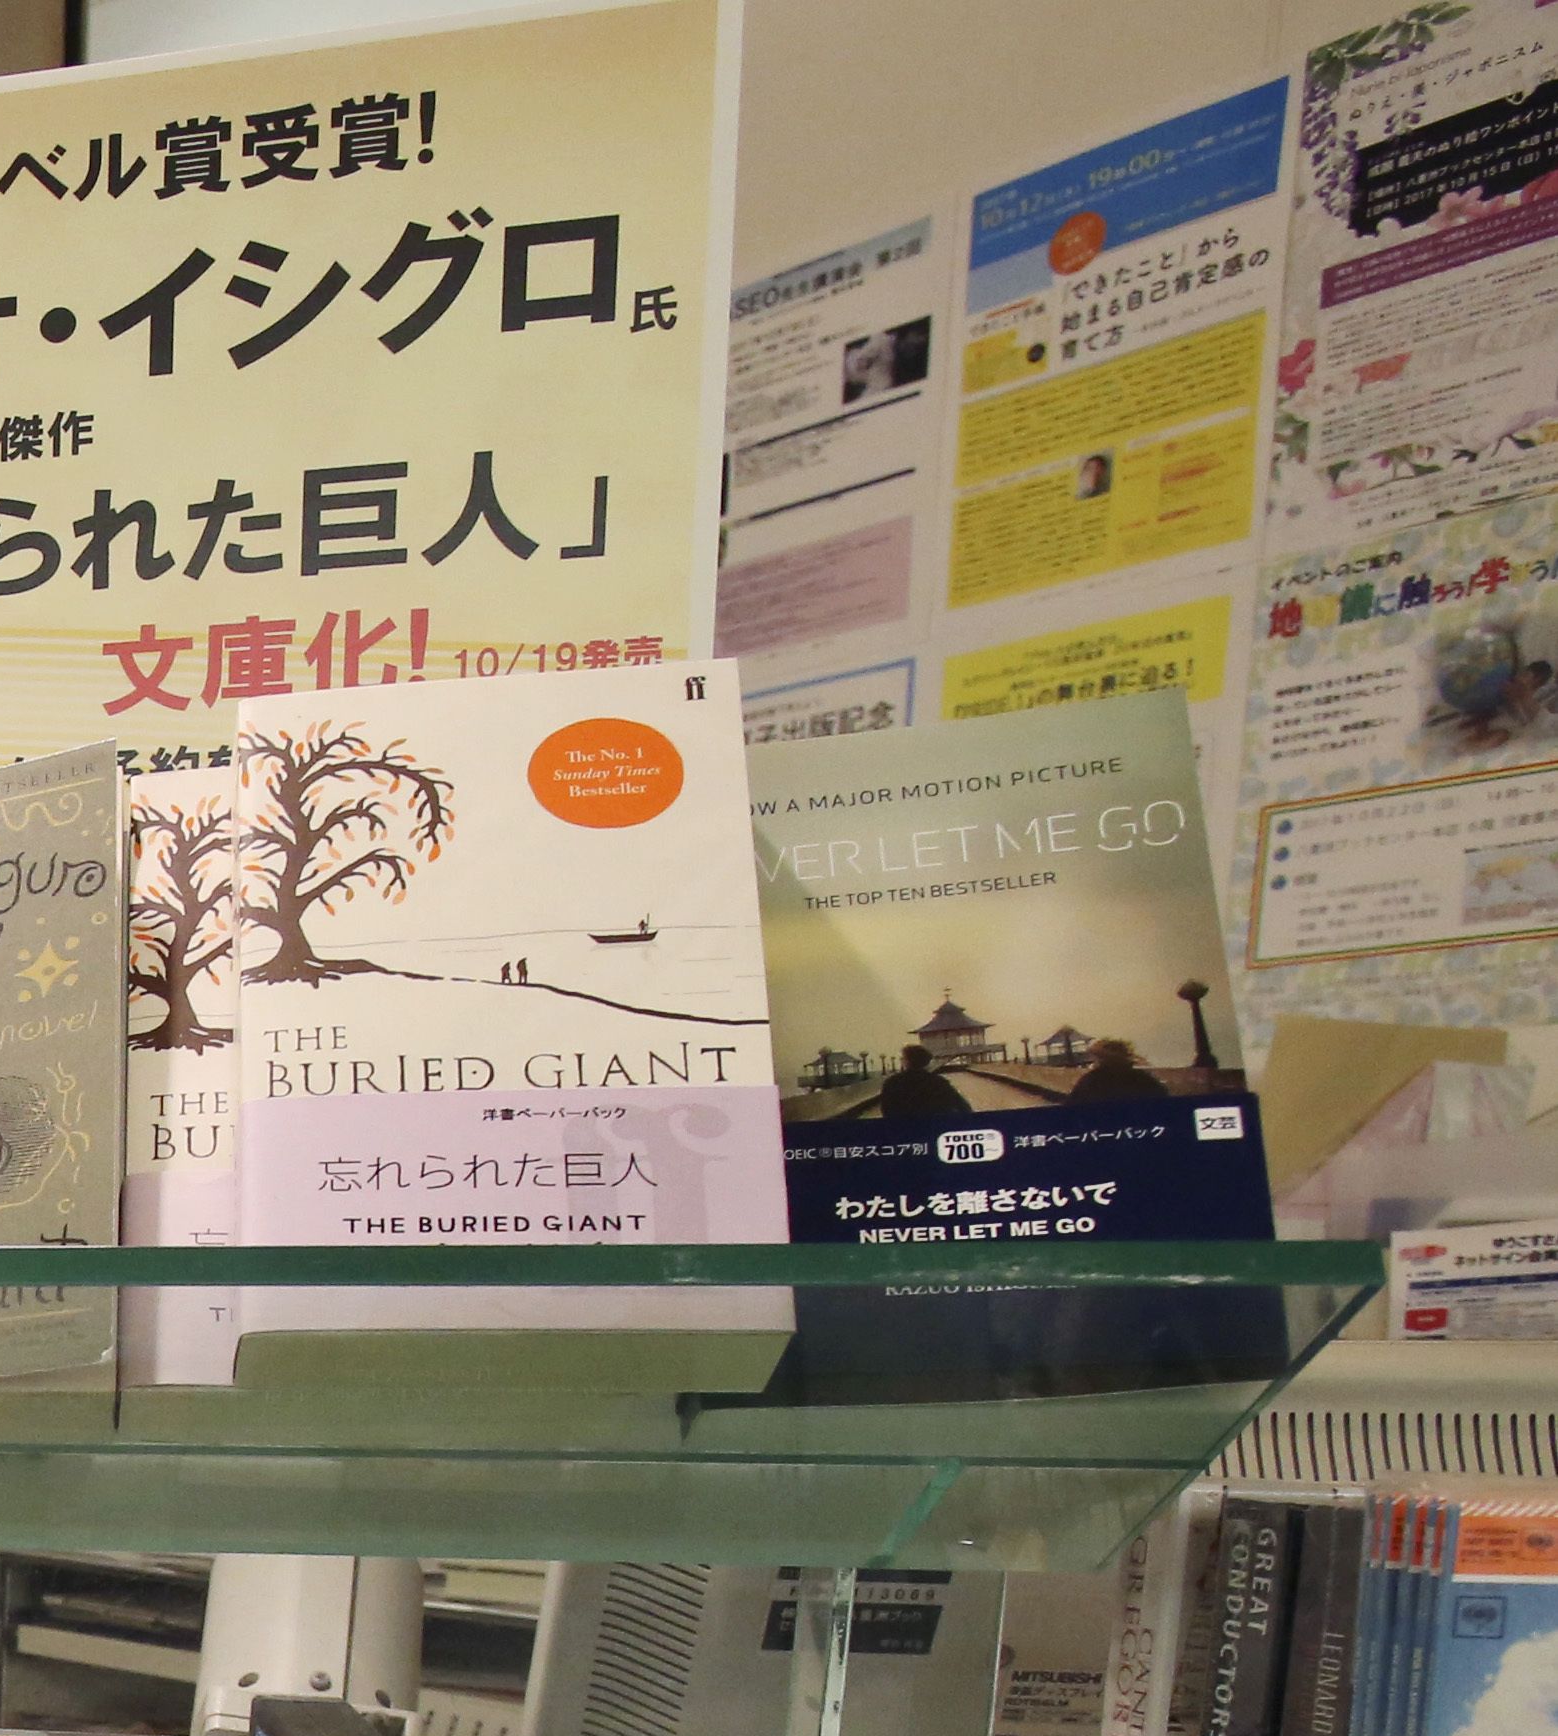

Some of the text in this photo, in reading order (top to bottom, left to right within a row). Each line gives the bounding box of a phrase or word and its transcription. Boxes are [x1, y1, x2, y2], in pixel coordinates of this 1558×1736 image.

[565, 747, 644, 764] The No. 1
[553, 765, 661, 782] Sunday Times
[785, 757, 1124, 815] A MAJOR MOTION PICTURE
[568, 782, 647, 798] Bestseller
[879, 799, 1186, 872] LET ME GO
[805, 871, 1058, 911] THE TOP TEN BESTSELLER
[263, 1025, 349, 1054] THE
[267, 1041, 738, 1099] BURIED GIANT
[149, 1091, 230, 1117] THE
[482, 1106, 628, 1122] 洋書ペーパーバック
[1013, 1124, 1166, 1150] 洋書ペーパーバック
[317, 1151, 659, 1192] 忘れられた巨人
[835, 1181, 1118, 1221] わたしを離さないで
[342, 1213, 647, 1234] THE BURIED GIANT
[858, 1216, 1097, 1244] NEVER LET ME GO
[1247, 1527, 1279, 1636] GREAT
[1312, 1632, 1345, 1734] LEONARD
